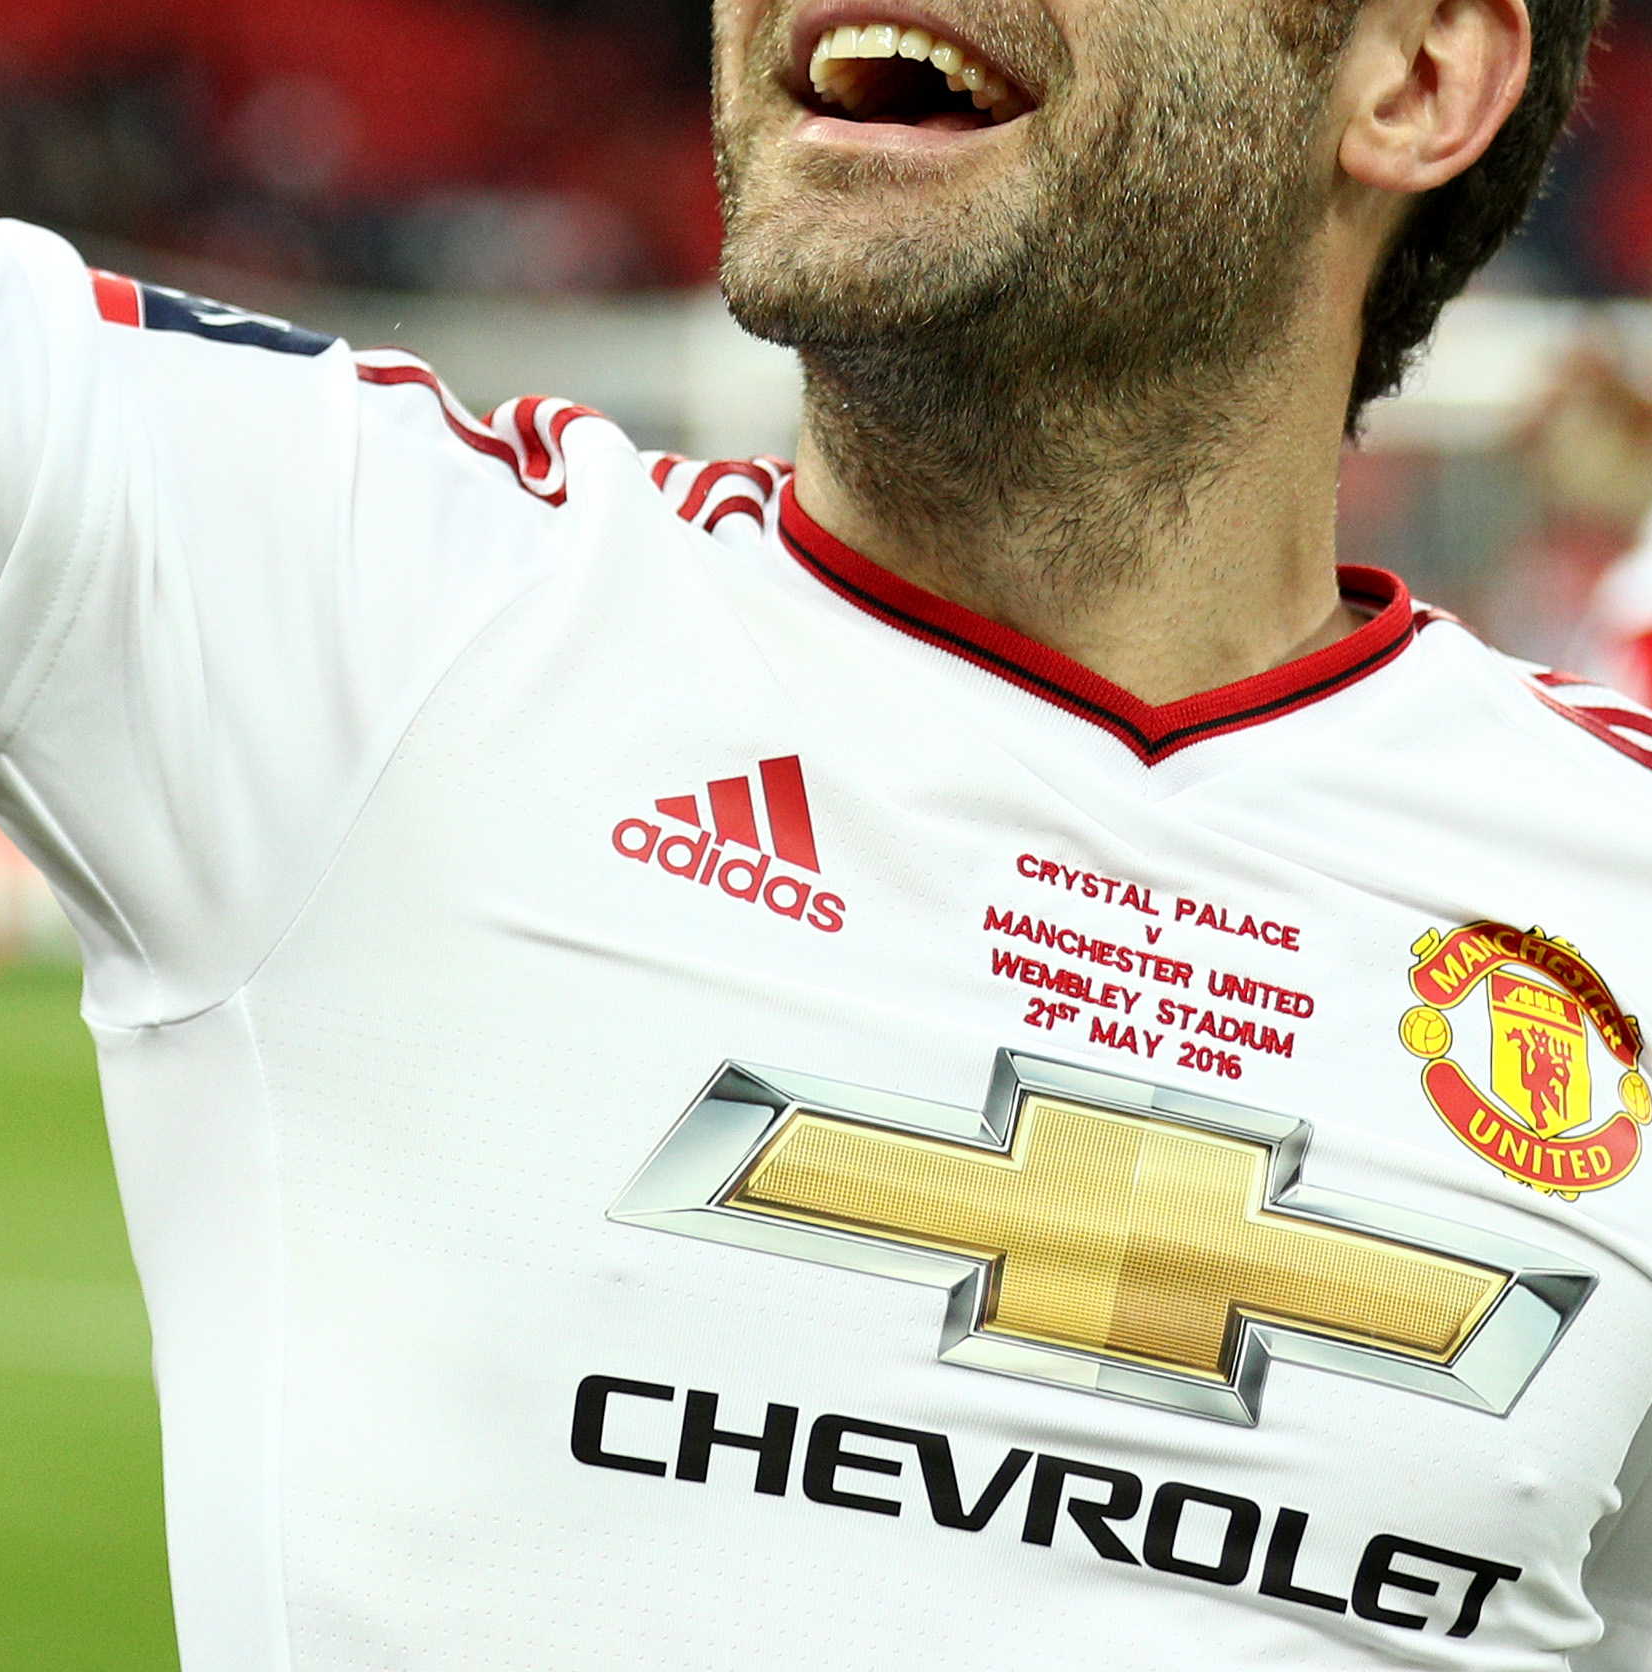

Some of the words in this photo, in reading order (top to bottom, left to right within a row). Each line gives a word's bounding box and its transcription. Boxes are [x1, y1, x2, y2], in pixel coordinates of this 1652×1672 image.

[612, 818, 846, 933] adidas
[1017, 853, 1159, 915] CRYSTAL
[1175, 897, 1300, 951] PALACE
[983, 905, 1193, 988] MANCHESTER
[1208, 970, 1314, 1019] UNITED
[992, 948, 1141, 1014] WEMBLEY
[1156, 998, 1295, 1058] STADIUM
[1429, 932, 1622, 1050] MANCHESTER
[1089, 1016, 1163, 1058] MAY
[1178, 1042, 1241, 1079] 2016
[1468, 1108, 1612, 1179] UNITED
[570, 1373, 1523, 1637] CHEVROLET
